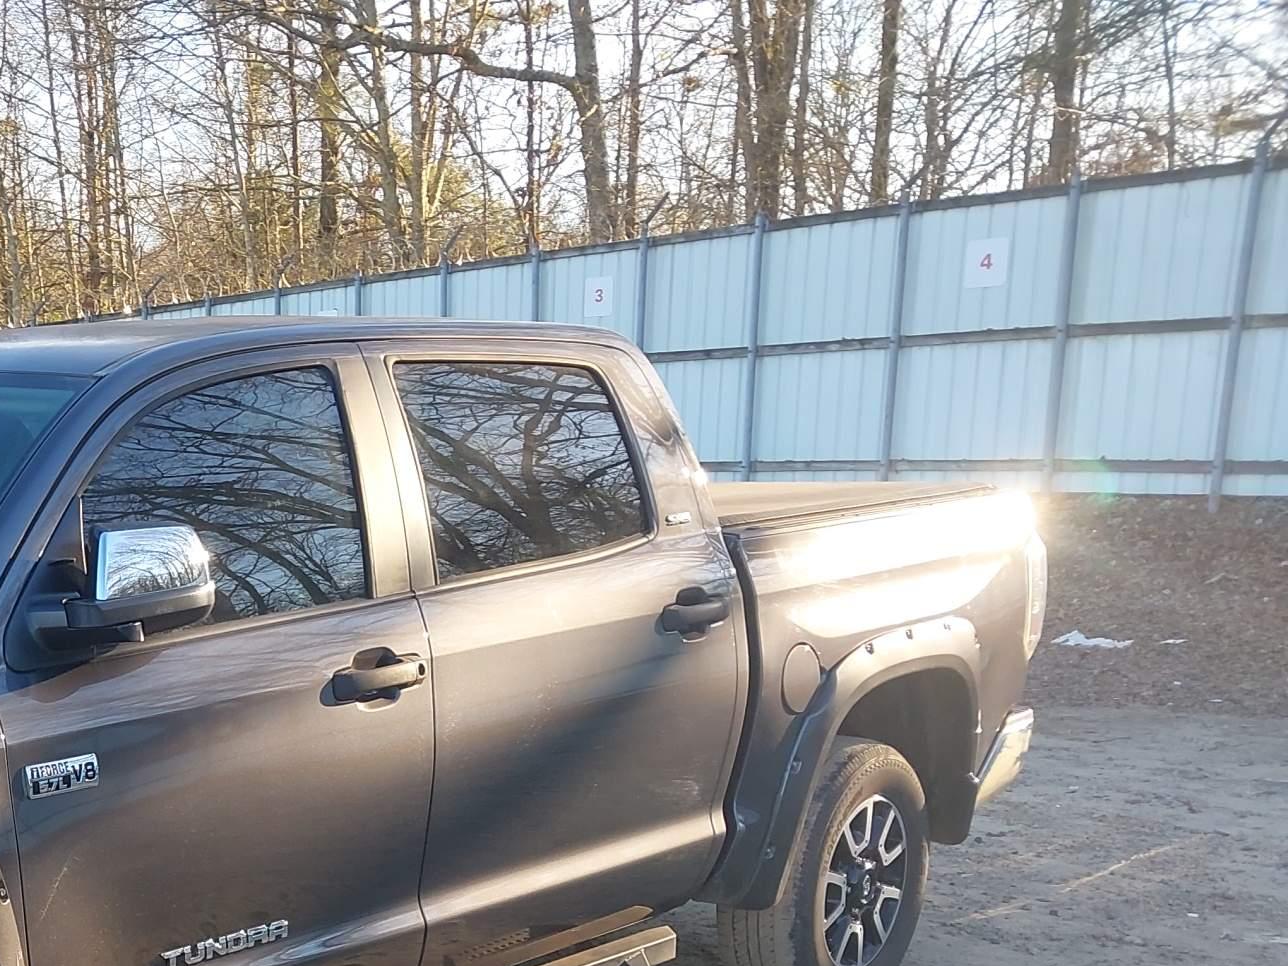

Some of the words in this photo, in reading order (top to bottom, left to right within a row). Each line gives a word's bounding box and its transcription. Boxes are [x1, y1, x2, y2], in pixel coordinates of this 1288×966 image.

[980, 253, 993, 270] 4
[595, 288, 604, 303] 3
[71, 761, 97, 783] V8
